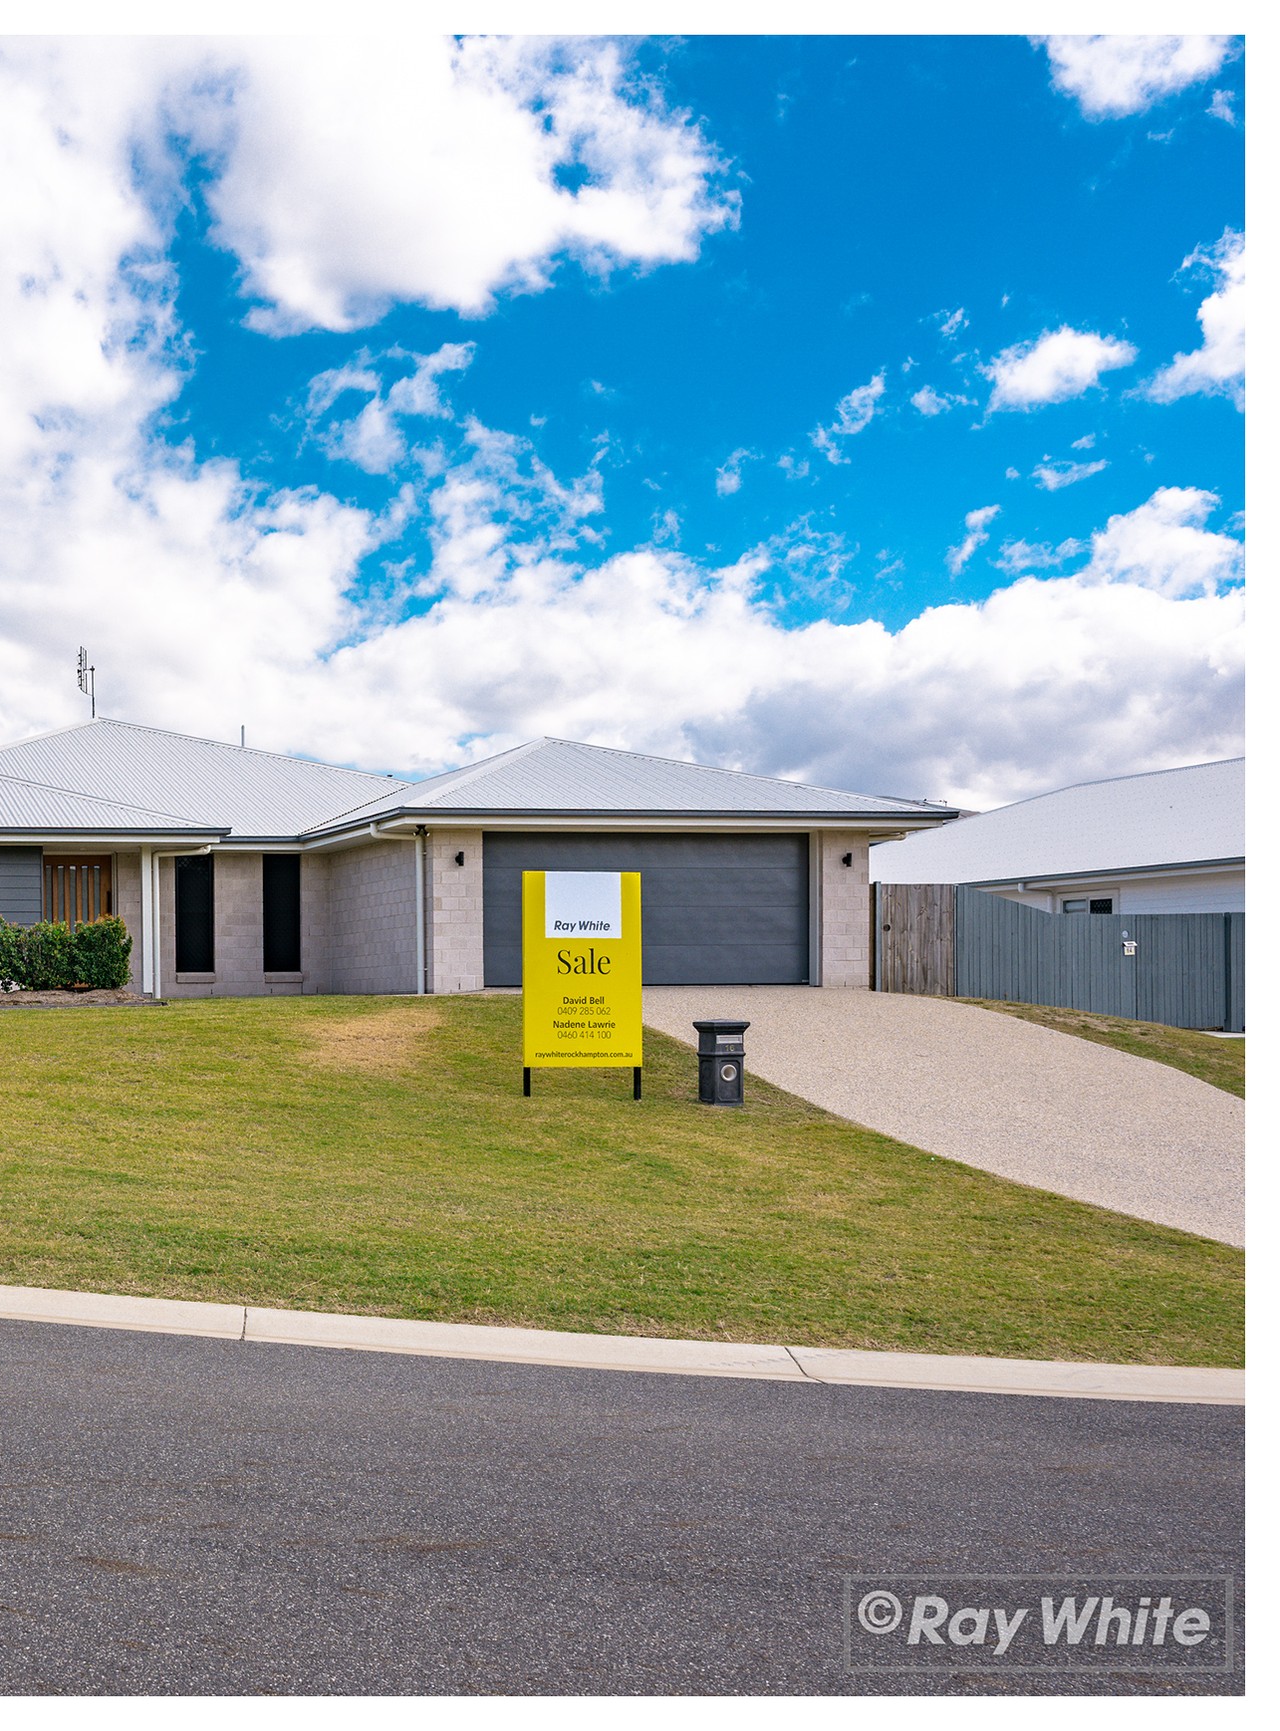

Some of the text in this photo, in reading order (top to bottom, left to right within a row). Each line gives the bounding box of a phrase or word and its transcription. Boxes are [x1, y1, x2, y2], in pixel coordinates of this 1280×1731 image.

[554, 920, 611, 932] Ray White
[557, 948, 611, 974] Sale
[563, 996, 605, 1005] David Bell
[557, 1006, 611, 1016] 0409 285 062
[553, 1020, 616, 1029] Nadene Lawrie
[557, 1030, 612, 1040] 0460 414 100
[535, 1051, 633, 1059] raywhiterockhampton.com.au
